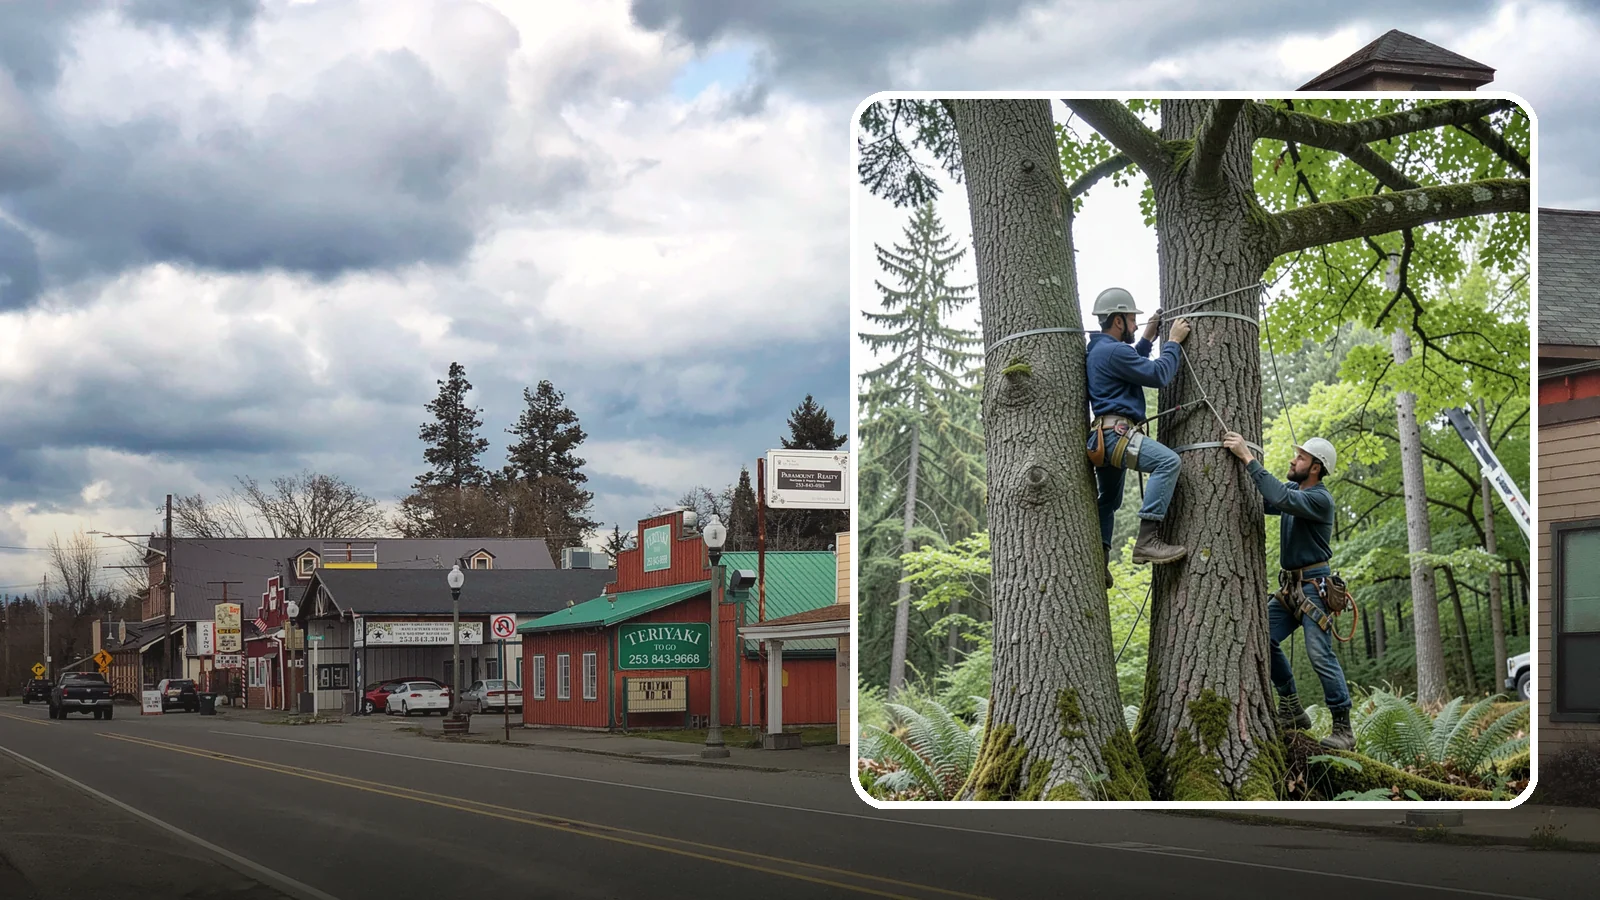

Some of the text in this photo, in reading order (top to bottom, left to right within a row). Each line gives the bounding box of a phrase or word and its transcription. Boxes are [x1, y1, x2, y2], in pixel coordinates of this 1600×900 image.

[781, 471, 838, 480] PARAMOUNT REALTY
[624, 628, 702, 646] TERIYAKI
[628, 654, 700, 664] 253 843-9668
